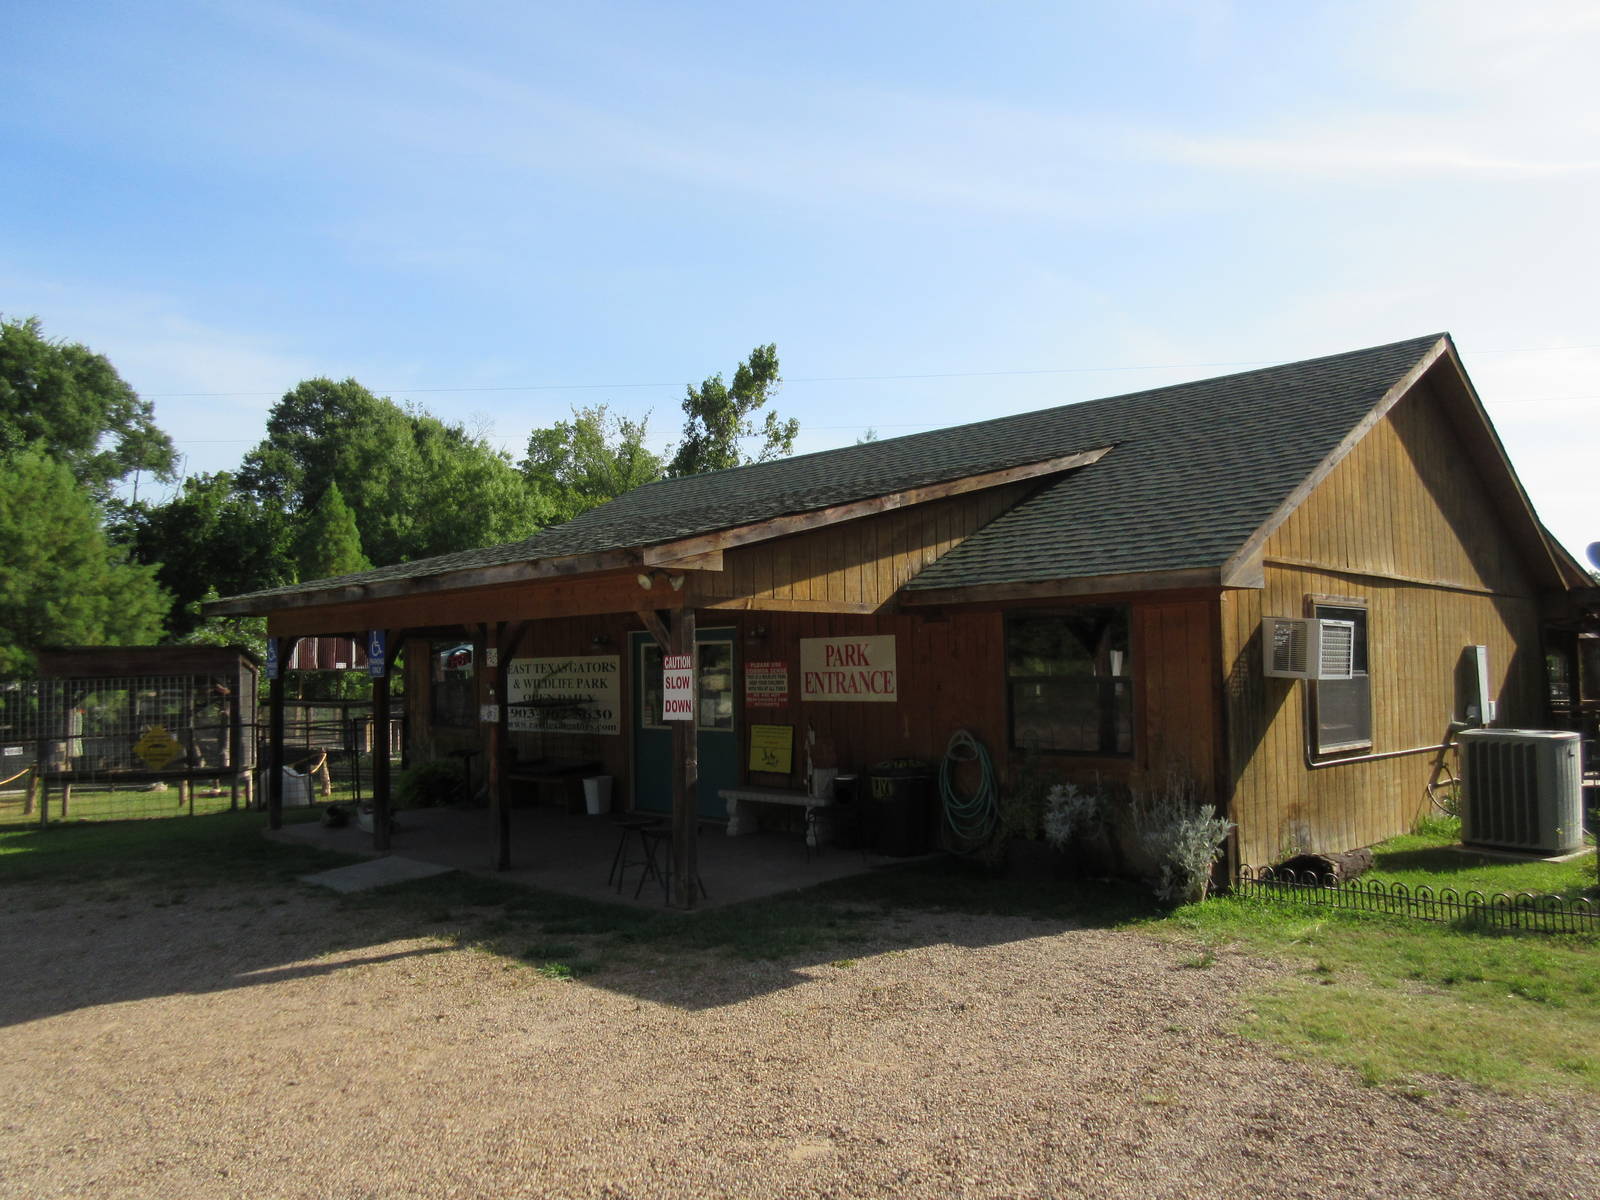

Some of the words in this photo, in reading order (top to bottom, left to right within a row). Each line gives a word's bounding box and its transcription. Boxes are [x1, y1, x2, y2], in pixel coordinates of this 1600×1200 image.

[664, 655, 691, 669] CAUTION
[825, 643, 870, 668] PARK
[569, 662, 617, 673] GATORS
[513, 679, 521, 689] &
[523, 678, 575, 689] WILDLIFE
[576, 678, 608, 689] PARK
[665, 676, 690, 689] SLOW
[805, 670, 895, 695] ENTRANCE
[665, 700, 691, 713] DOWN
